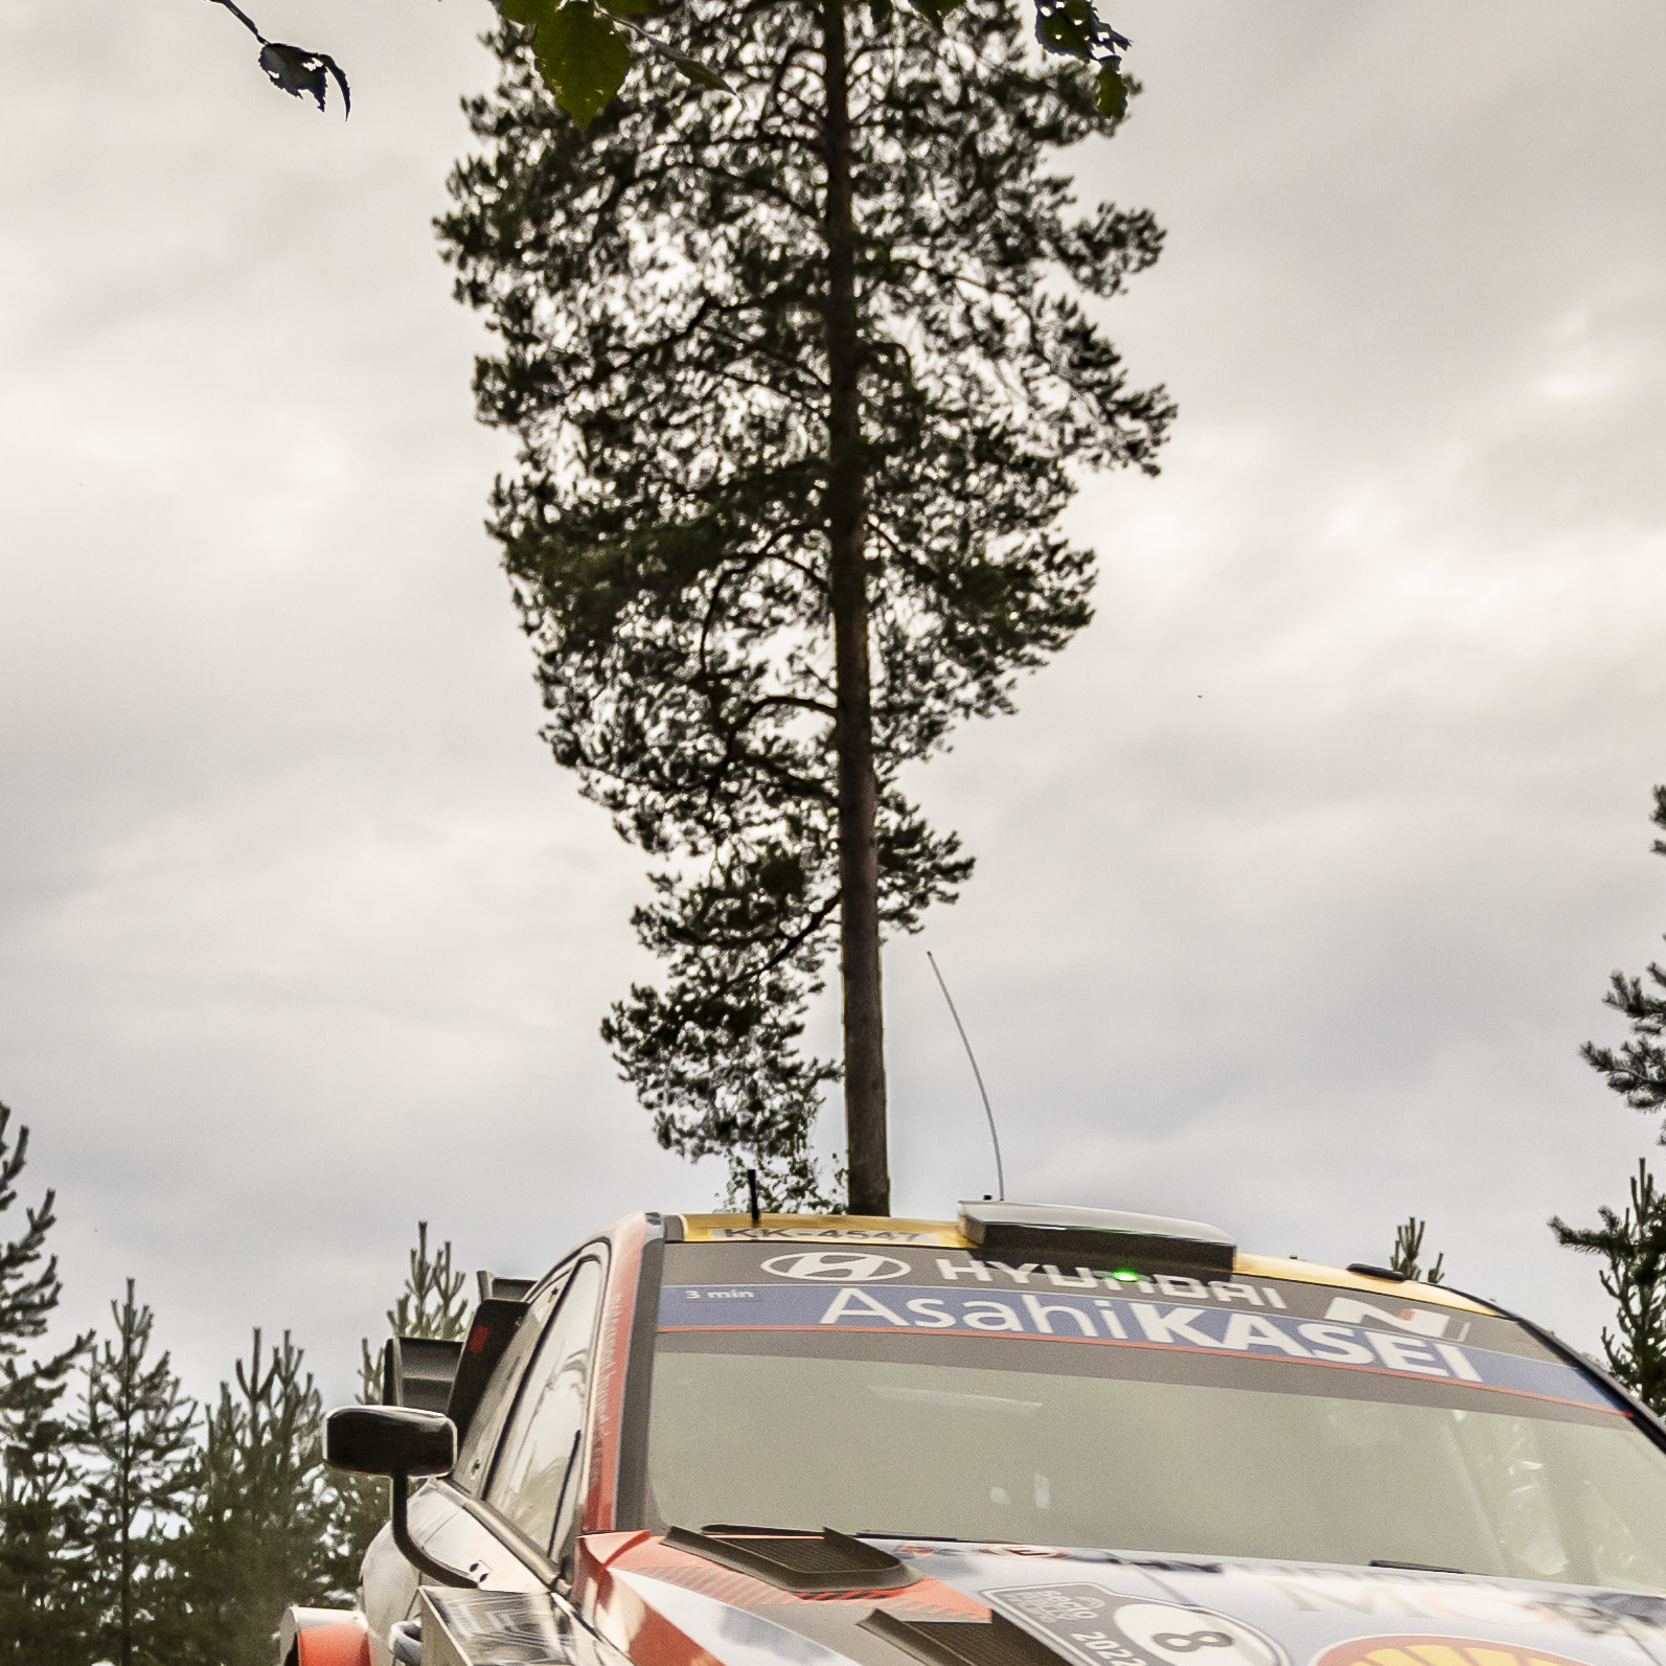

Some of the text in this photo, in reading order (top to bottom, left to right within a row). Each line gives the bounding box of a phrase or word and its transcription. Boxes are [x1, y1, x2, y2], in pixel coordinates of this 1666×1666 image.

[686, 1288, 756, 1300] 3 min
[821, 1287, 1484, 1384] AsahiKASEI
[1153, 1631, 1232, 1651] 8
